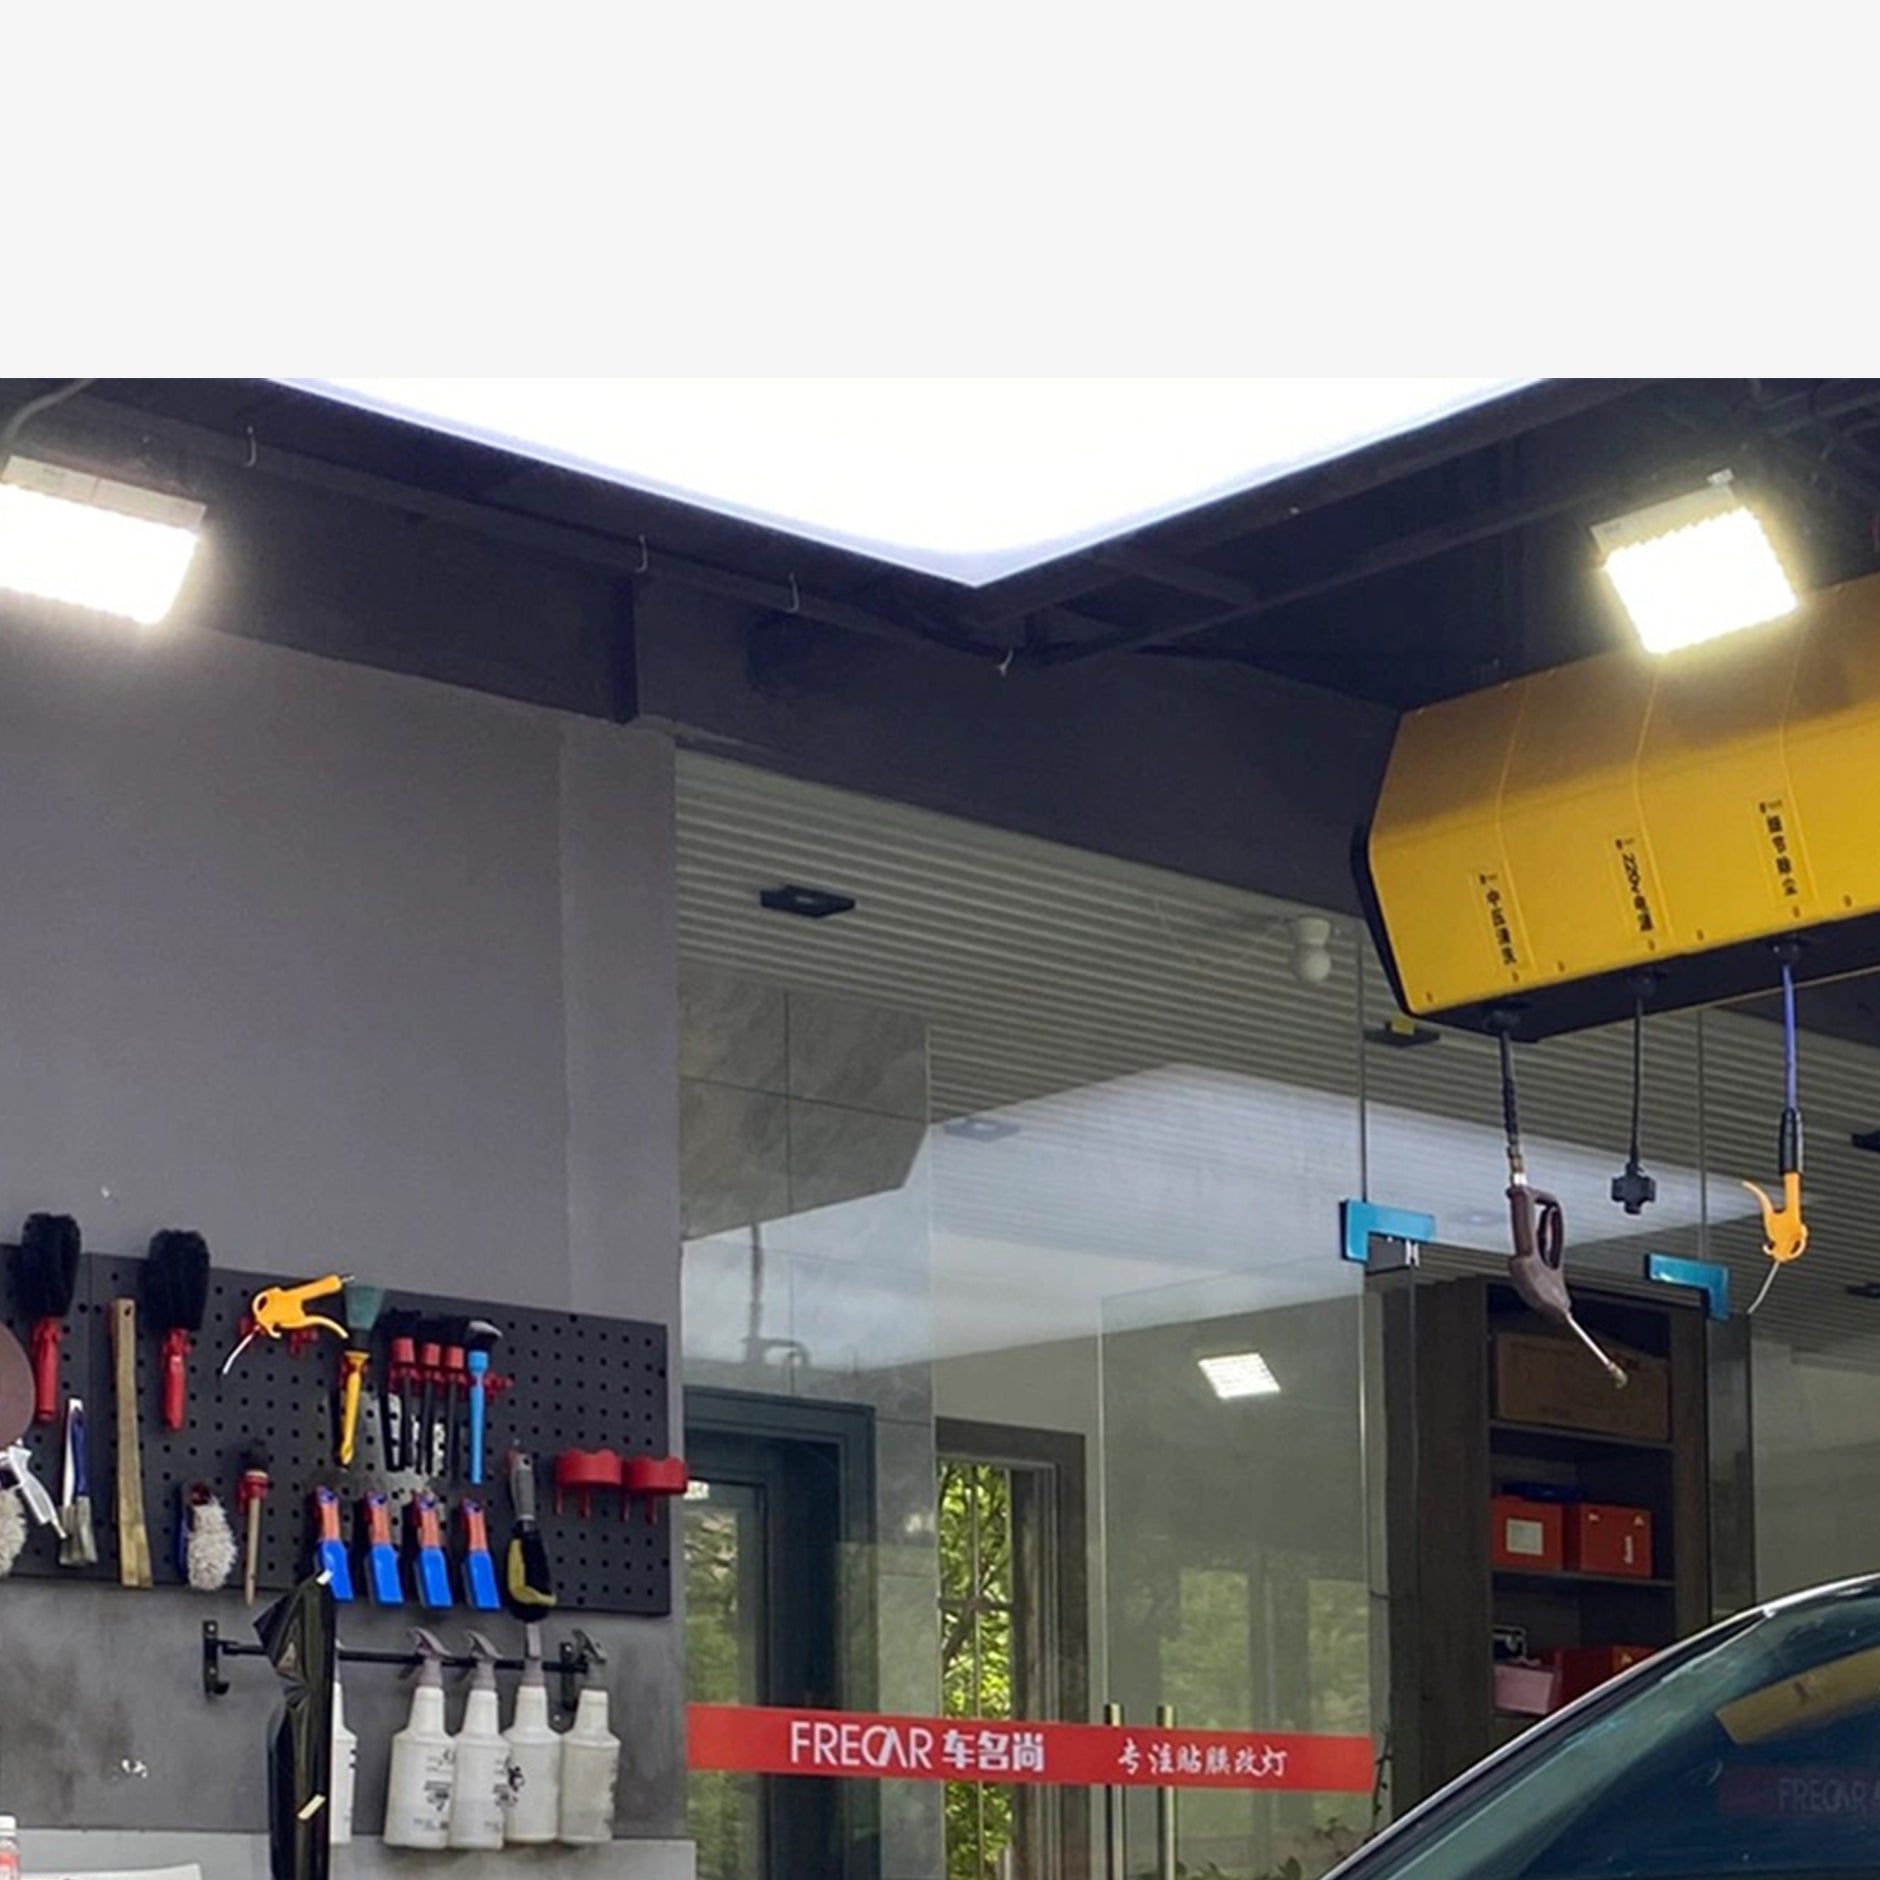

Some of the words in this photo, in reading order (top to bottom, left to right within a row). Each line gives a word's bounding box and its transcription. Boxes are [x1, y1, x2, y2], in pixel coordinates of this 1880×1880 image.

[790, 1721, 933, 1769] FRECAR
[942, 1730, 1046, 1773] 车名尚
[1116, 1737, 1289, 1778] 专注贴膜改灯
